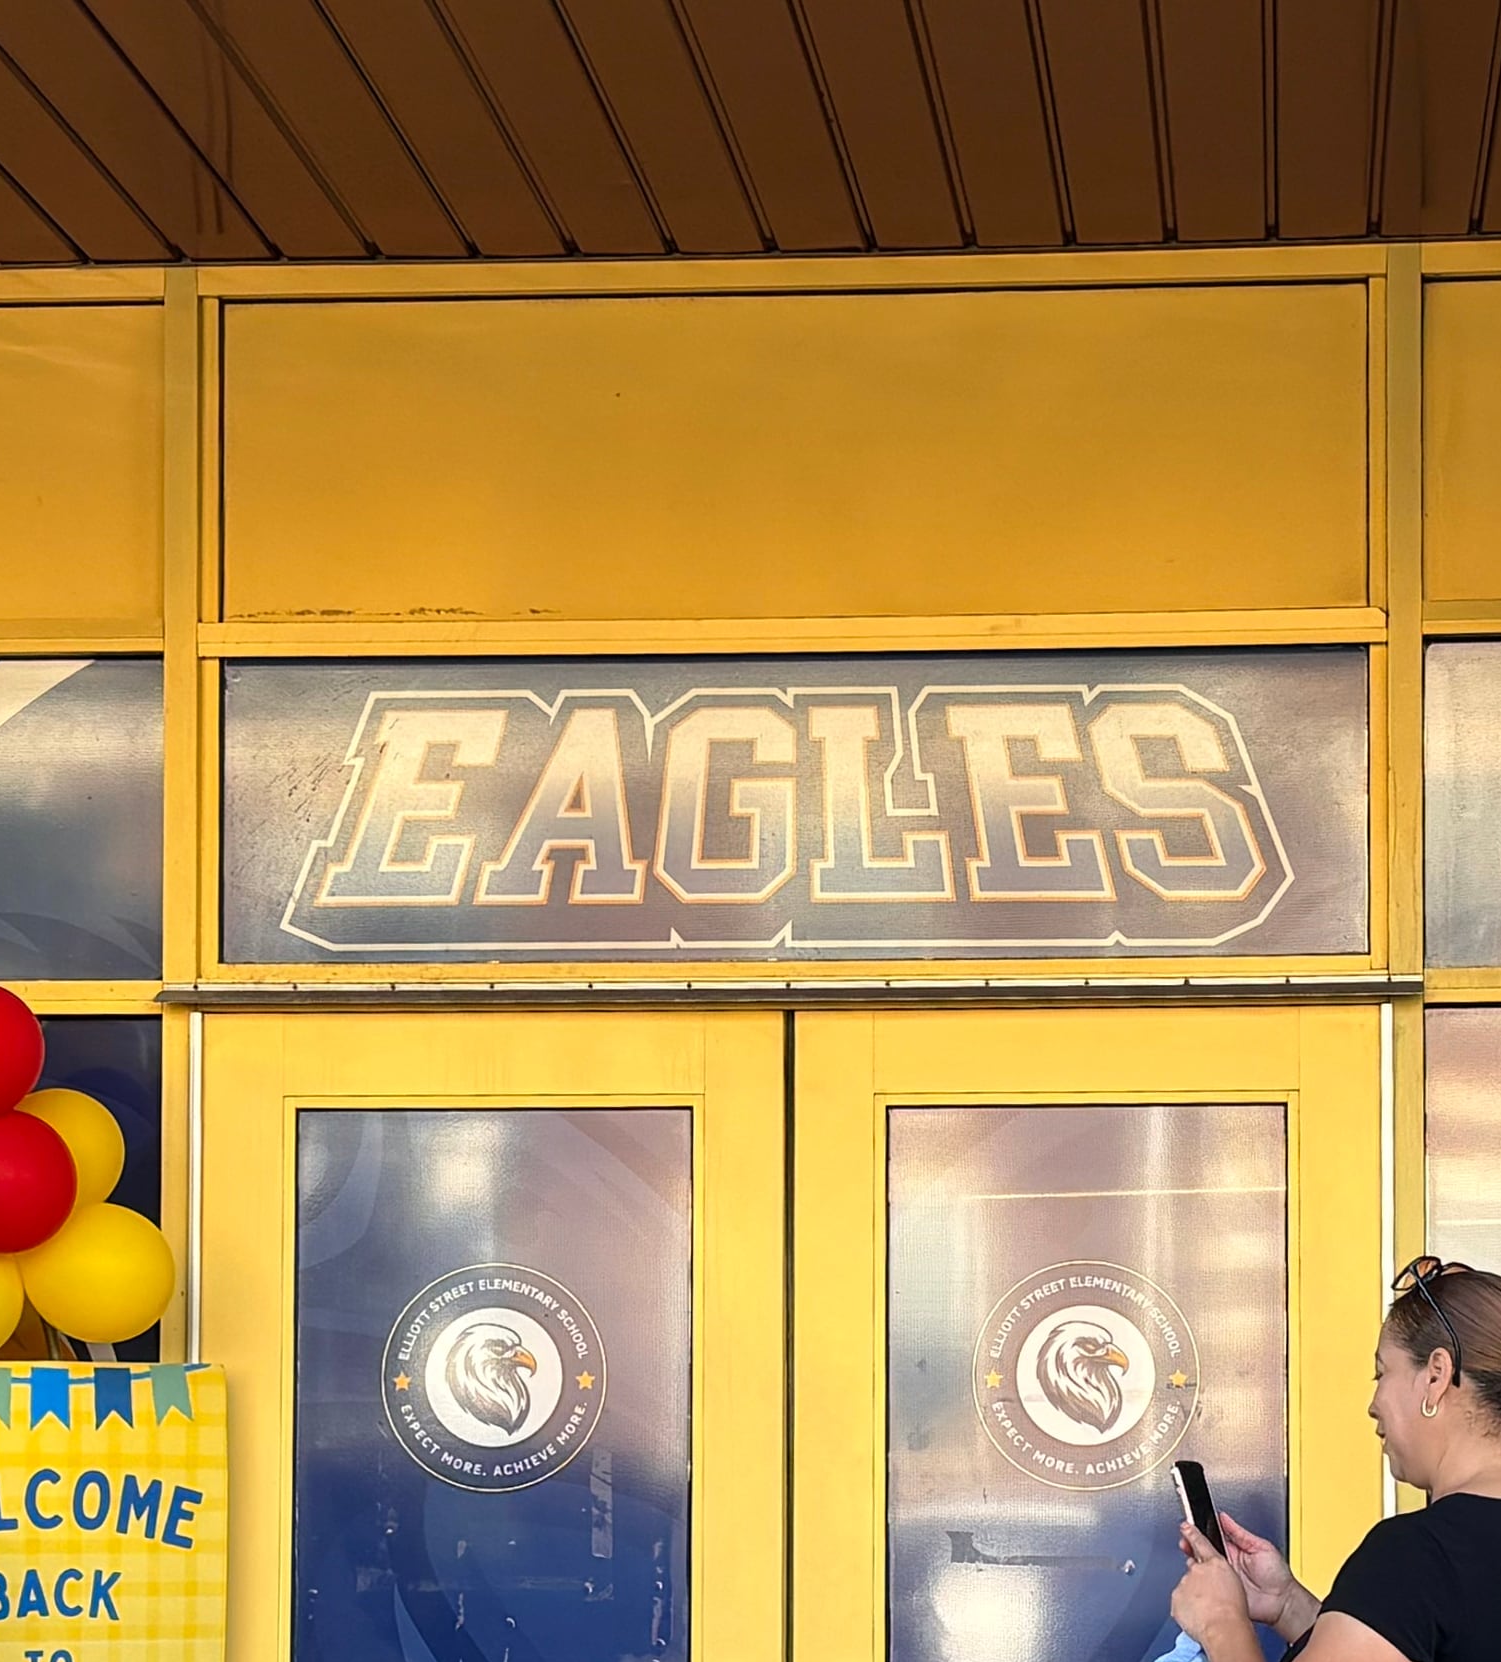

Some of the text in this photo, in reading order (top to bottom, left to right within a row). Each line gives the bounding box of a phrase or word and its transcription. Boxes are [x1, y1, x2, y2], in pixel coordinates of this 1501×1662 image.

[313, 704, 1266, 904] EAGLES
[398, 1279, 589, 1361] ELLIOTT STREET ELEMENTARY SCHOOL
[989, 1276, 1182, 1359] ELLIOTT STREET ELEMENTARY SCHOOL
[401, 1402, 588, 1477] EXPECT MORE. ACHIEVE MORE.
[992, 1400, 1181, 1475] EXPECT MORE. ACHIEVE MORE.
